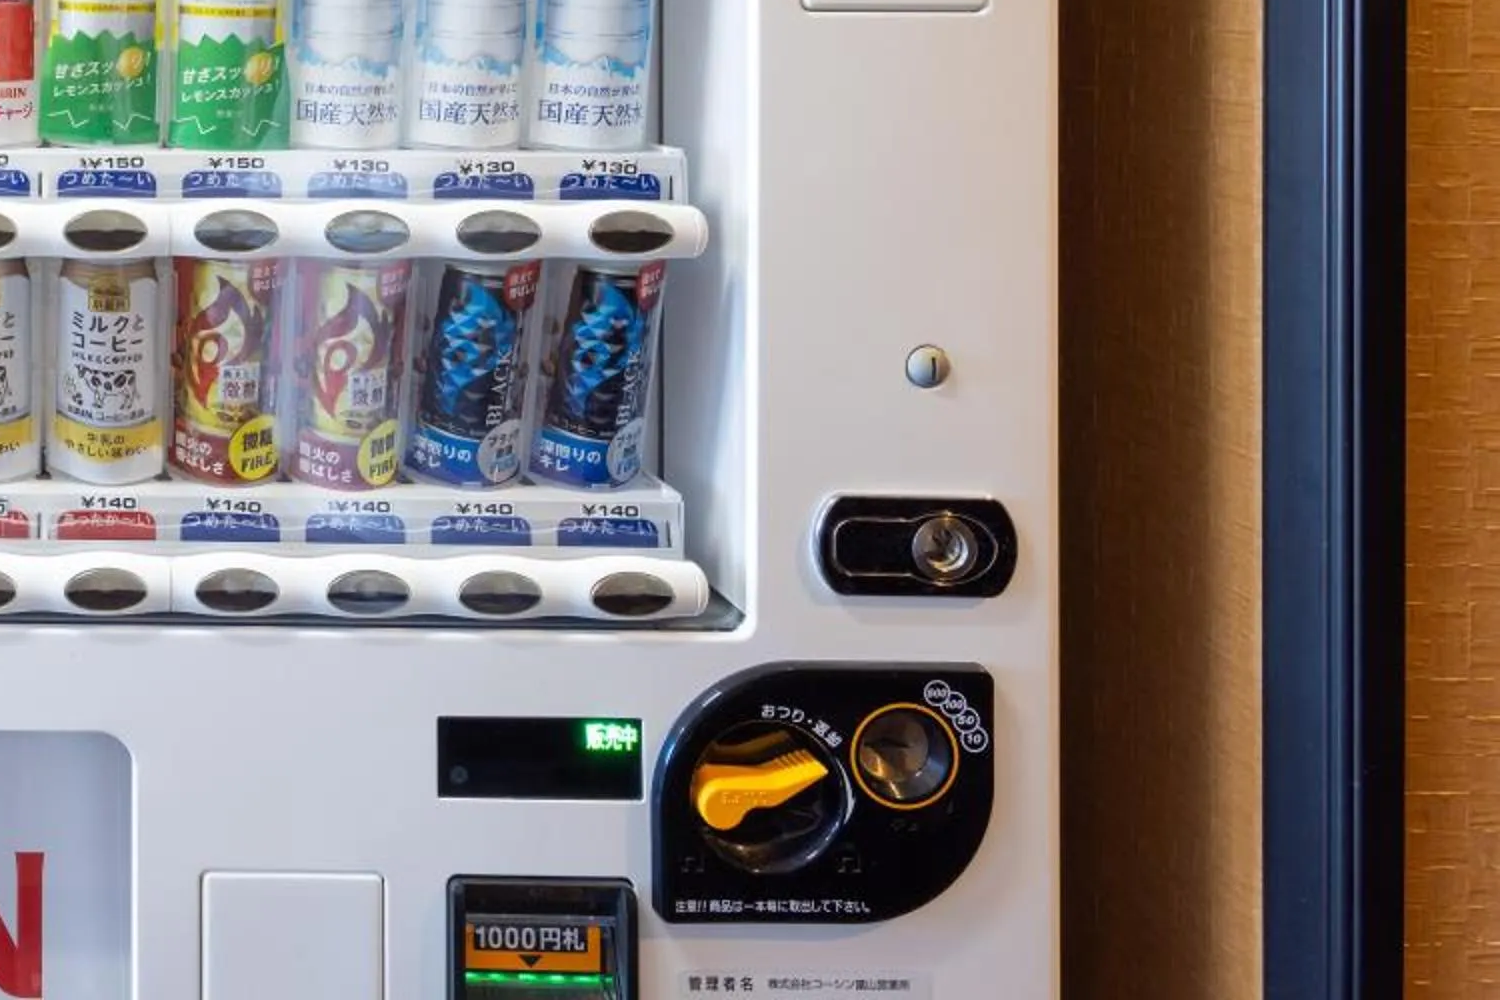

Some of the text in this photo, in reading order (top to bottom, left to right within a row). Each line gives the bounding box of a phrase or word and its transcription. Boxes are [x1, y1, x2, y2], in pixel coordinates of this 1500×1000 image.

[87, 157, 144, 169] ¥150
[209, 158, 265, 169] ¥150
[333, 160, 389, 173] ¥130
[460, 161, 515, 175] ¥130
[582, 160, 638, 175] ¥130
[73, 311, 145, 334] ミルクと
[72, 331, 143, 353] コーヒー
[486, 344, 512, 426] BLACK
[81, 496, 137, 509] ¥140
[207, 500, 261, 513] ¥140
[336, 501, 390, 513] ¥140
[456, 503, 513, 515] ¥140
[582, 505, 638, 517] ¥140
[585, 723, 638, 751] 販売中
[967, 734, 981, 744] 10
[476, 926, 585, 951] 1000円札
